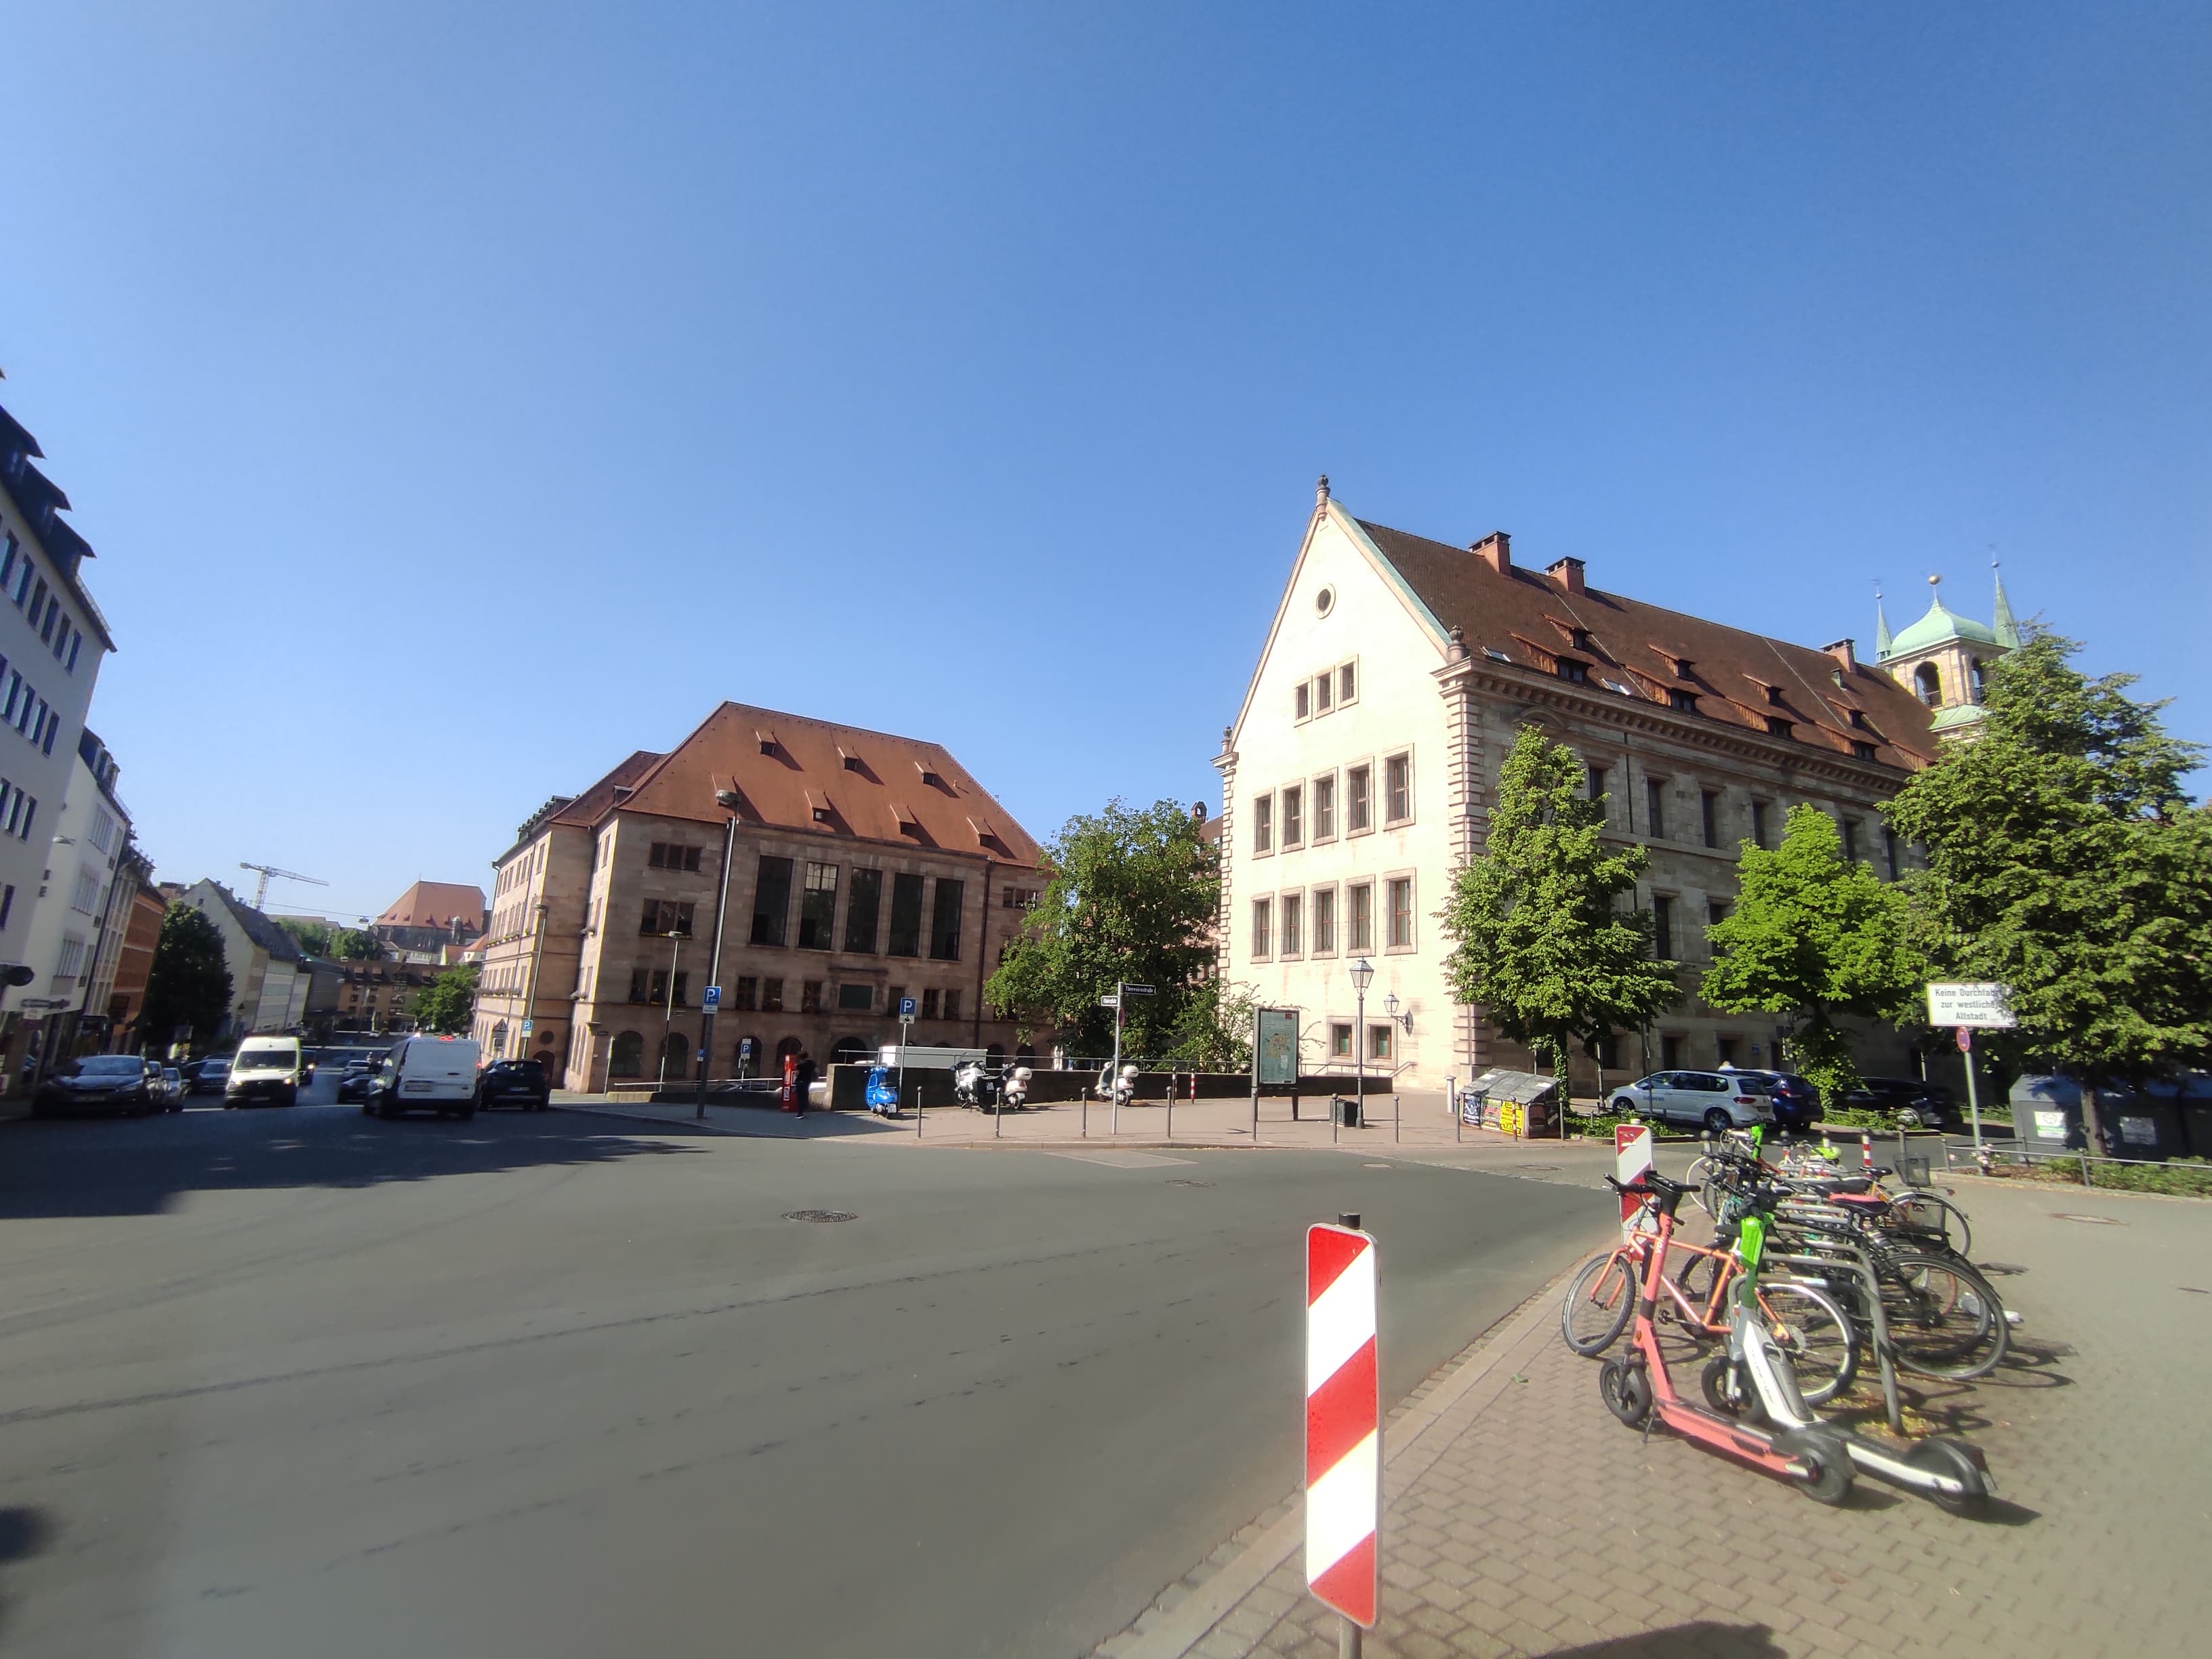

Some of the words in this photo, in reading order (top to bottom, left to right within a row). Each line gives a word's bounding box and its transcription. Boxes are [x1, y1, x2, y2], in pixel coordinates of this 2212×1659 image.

[707, 989, 716, 1002] P
[904, 1000, 912, 1012] P
[743, 1044, 749, 1052] P
